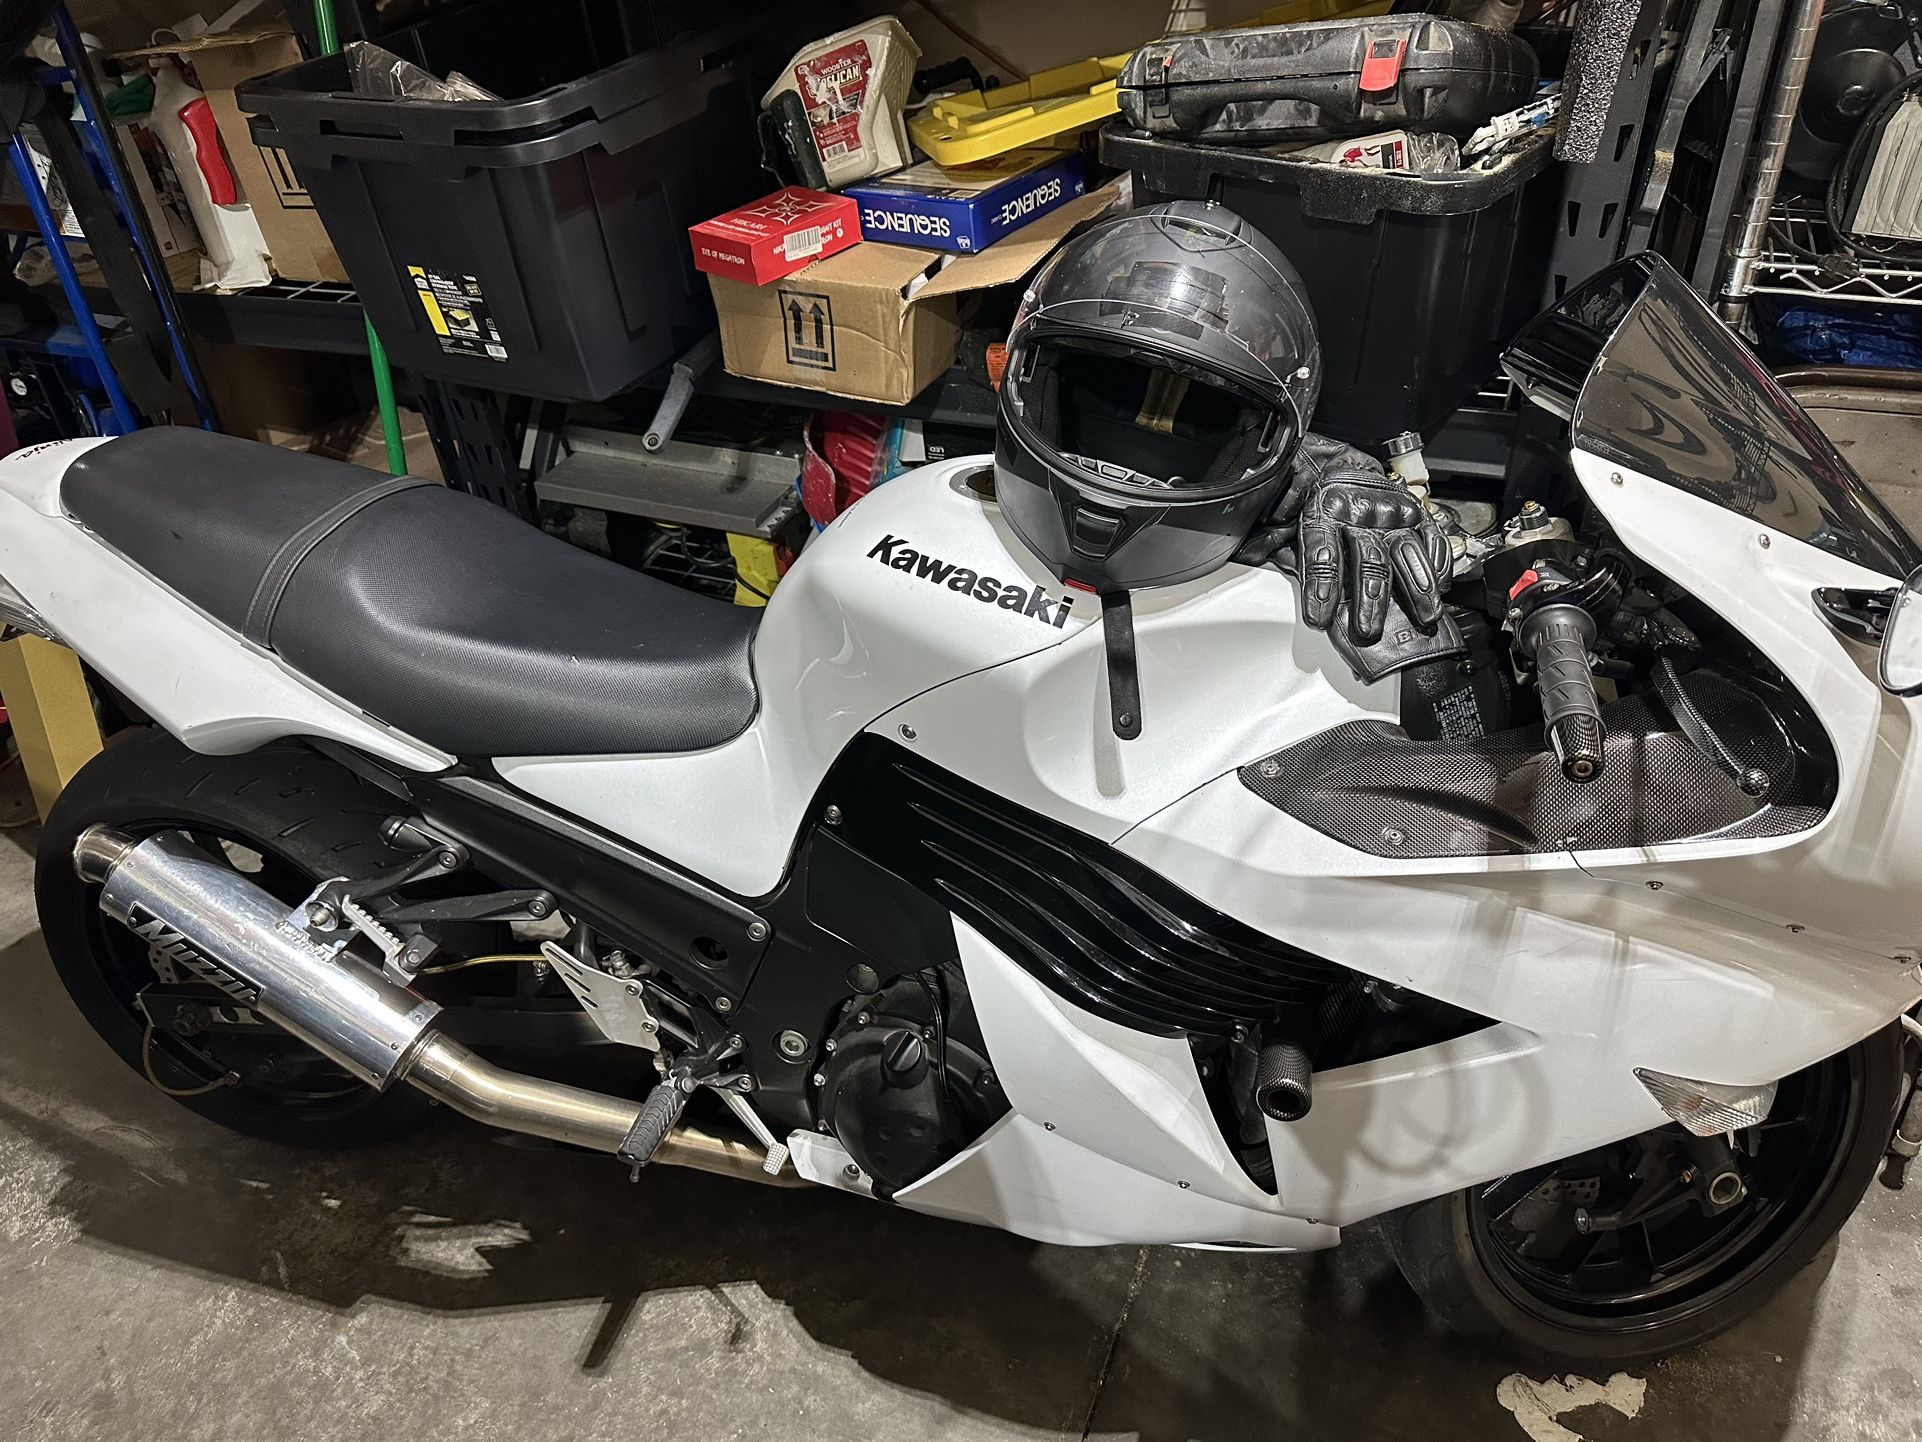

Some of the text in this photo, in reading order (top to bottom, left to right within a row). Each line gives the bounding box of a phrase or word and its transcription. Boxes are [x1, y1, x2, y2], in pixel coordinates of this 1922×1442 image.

[820, 58, 852, 75] WOOSTER
[1001, 177, 1061, 226] SEQUENCE
[863, 208, 951, 238] SEQUENCE
[866, 534, 1075, 630] Kawasaki
